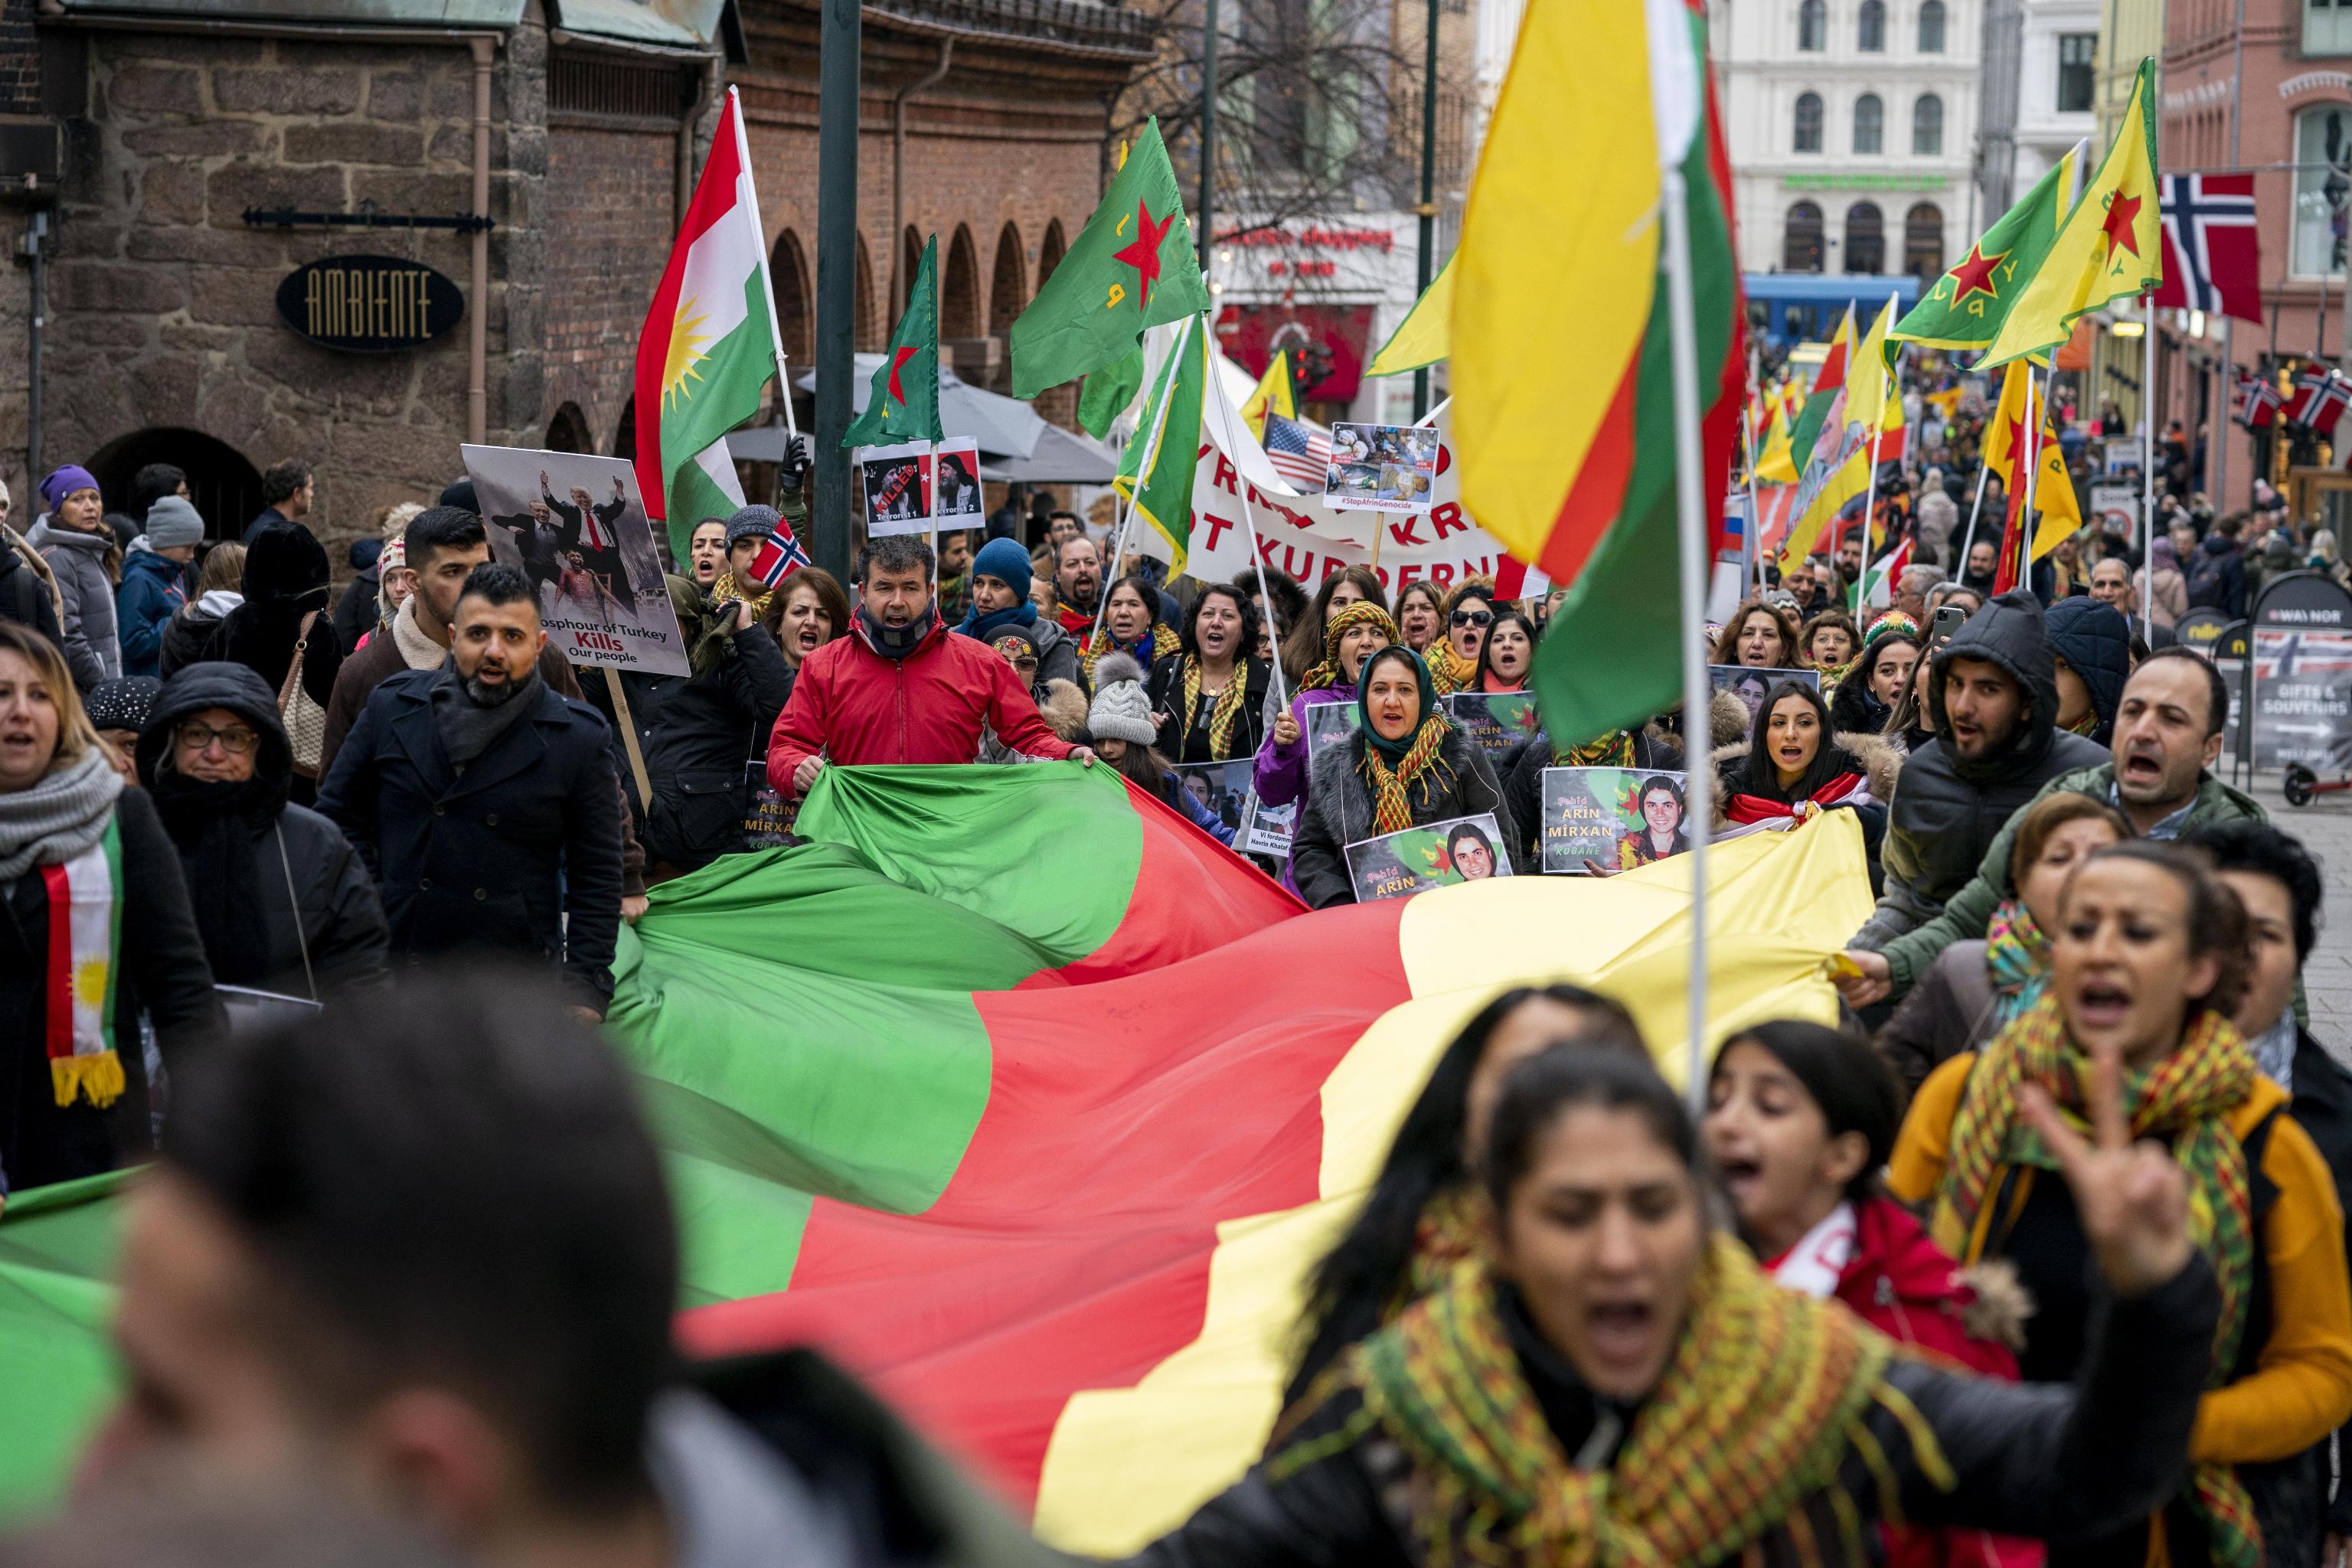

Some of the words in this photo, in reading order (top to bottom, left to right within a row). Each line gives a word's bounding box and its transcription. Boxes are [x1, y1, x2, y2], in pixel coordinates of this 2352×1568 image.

[305, 269, 433, 338] AMBIENTE
[874, 464, 915, 514] KILLED
[937, 505, 967, 514] errorist
[1341, 498, 1413, 509] #StopAfrinGenocide
[876, 511, 911, 521] Terrorist
[2311, 609, 2341, 624] NOR
[541, 618, 599, 632] osphour
[603, 623, 617, 634] of
[618, 625, 667, 643] Turkey
[575, 631, 624, 652] Kills
[569, 647, 592, 658] Our
[594, 651, 638, 664] people
[2278, 684, 2322, 700] GIFTS
[2262, 699, 2348, 717] SOUVENIRS
[1562, 806, 1601, 820] ARÎN
[745, 818, 793, 834] MÎRXA
[1548, 824, 1612, 838] MÎRXAN
[1250, 838, 1269, 847] Havrin
[1269, 842, 1287, 851] Khalaf
[1267, 834, 1292, 843] fordømm
[1376, 877, 1416, 897] ARÎN
